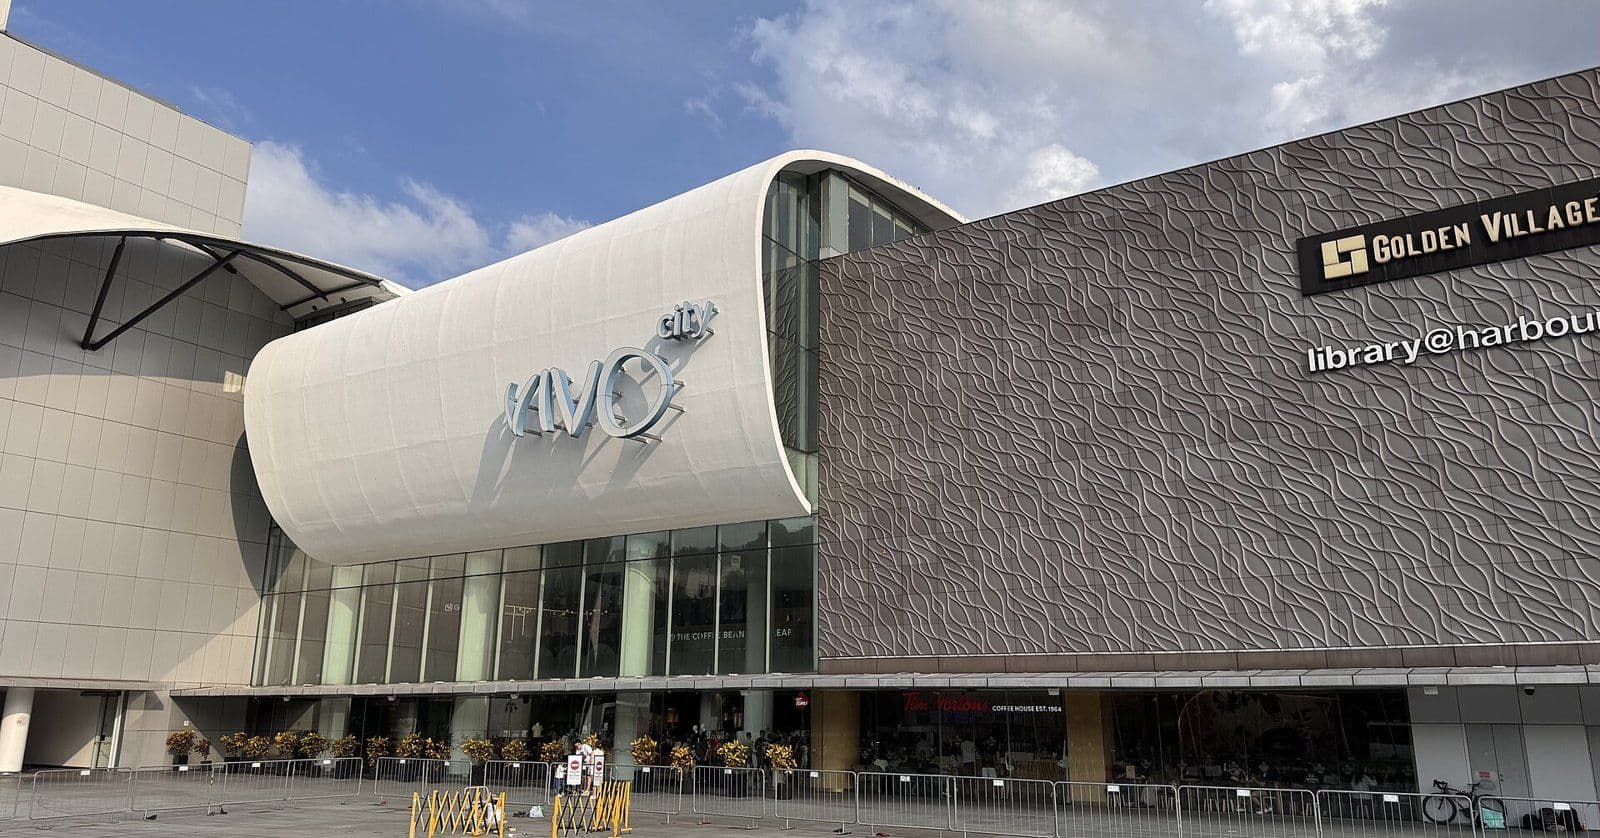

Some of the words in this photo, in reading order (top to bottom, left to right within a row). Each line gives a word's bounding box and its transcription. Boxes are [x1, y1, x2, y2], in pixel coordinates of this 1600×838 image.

[1372, 222, 1471, 264] GOLDEN
[1481, 197, 1600, 243] VILLAGE
[656, 300, 716, 340] city
[723, 629, 745, 639] BEAN
[936, 692, 990, 712] ortons
[992, 704, 1014, 712] COFFEE
[1015, 704, 1035, 712] HOUSE
